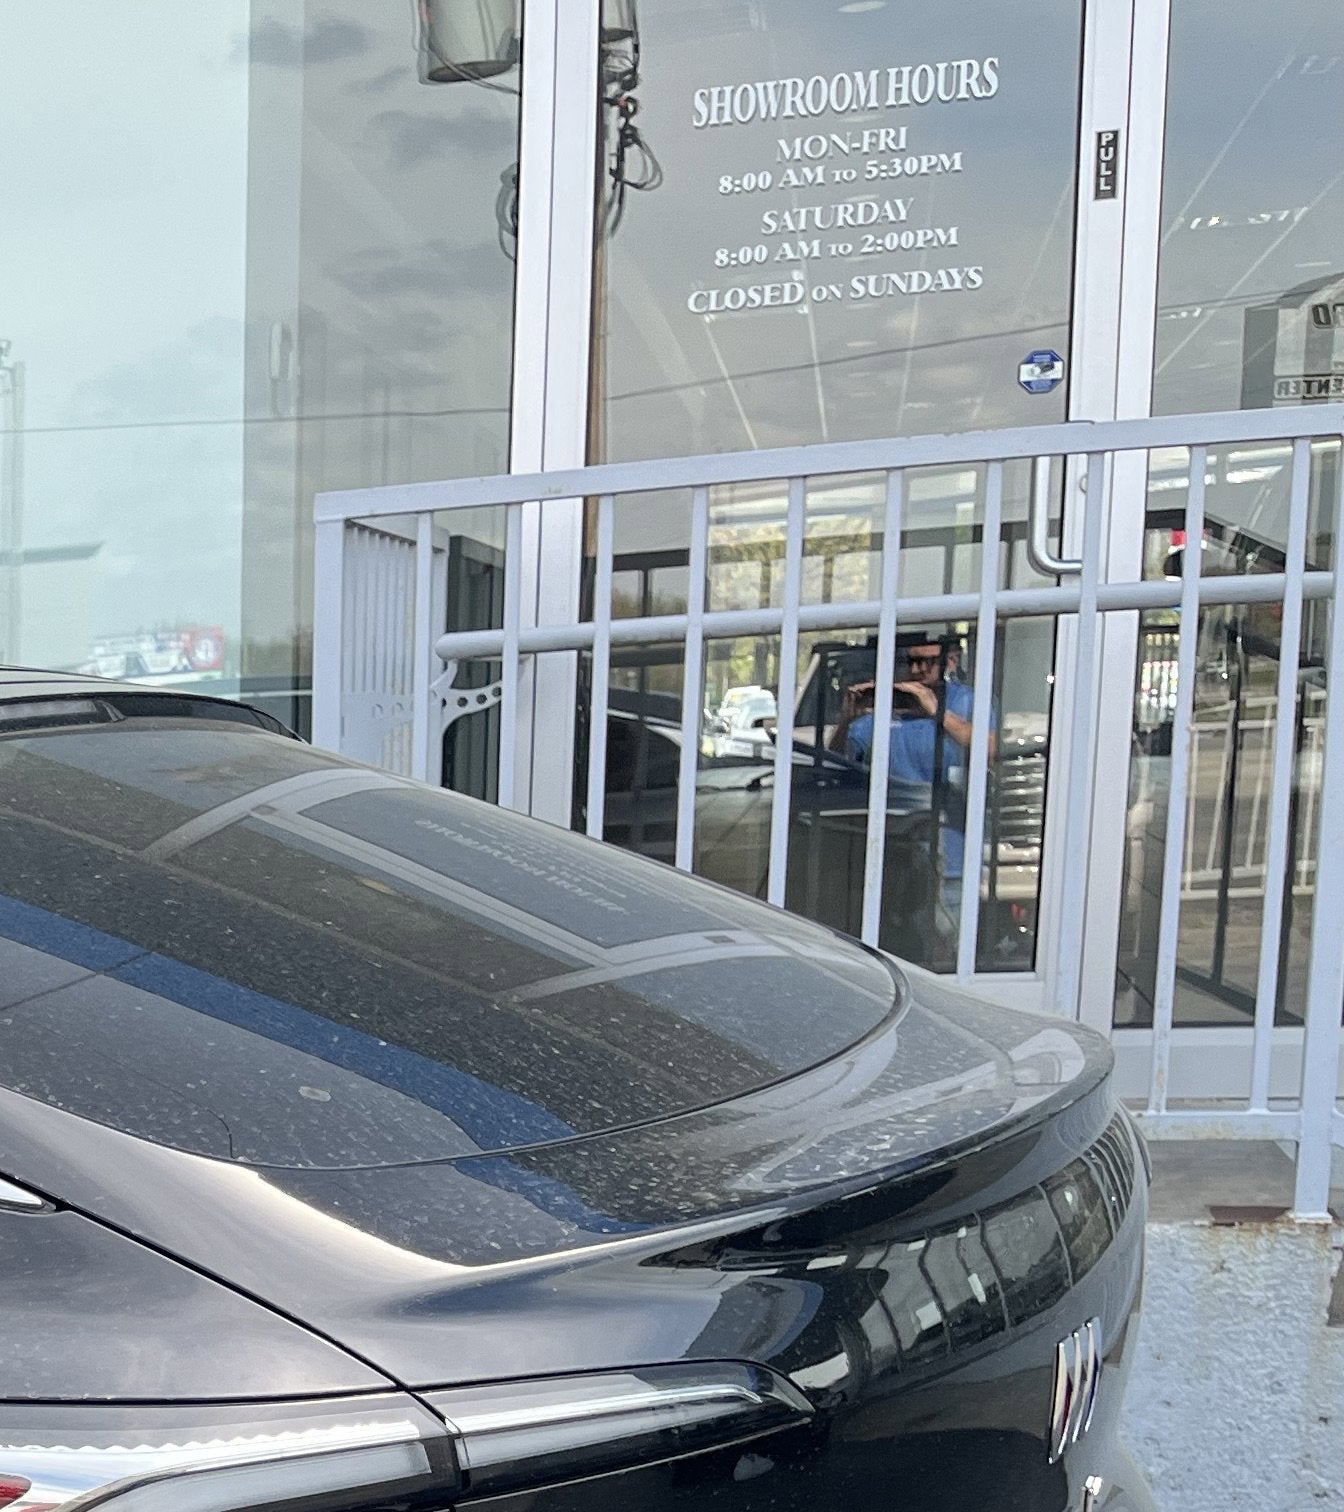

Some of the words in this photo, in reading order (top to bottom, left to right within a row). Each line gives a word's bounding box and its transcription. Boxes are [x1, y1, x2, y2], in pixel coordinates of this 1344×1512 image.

[693, 69, 880, 127] SHOWROOM
[886, 57, 999, 106] HOURS
[776, 126, 908, 162] MON-FRI
[1100, 132, 1114, 191] PULL
[718, 170, 773, 194] 8:00
[779, 165, 825, 187] AM
[864, 152, 963, 180] 5:30PM
[761, 197, 915, 235] SATURDAY
[714, 245, 768, 267] 8:00
[775, 239, 821, 261] AM
[860, 226, 959, 253] 2:00PM
[687, 281, 804, 313] CLOSED
[850, 265, 984, 299] SUNDAYS
